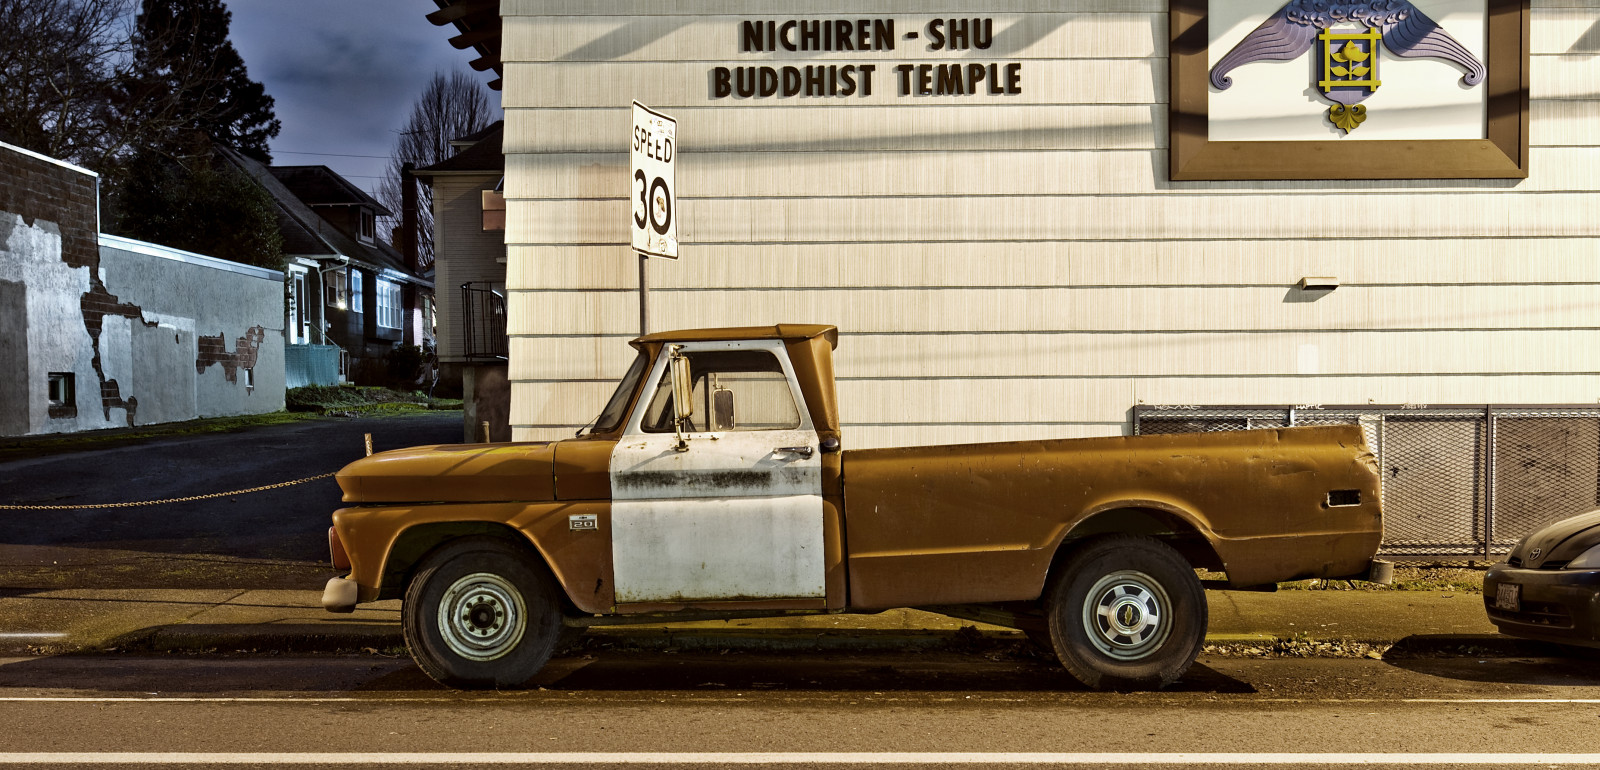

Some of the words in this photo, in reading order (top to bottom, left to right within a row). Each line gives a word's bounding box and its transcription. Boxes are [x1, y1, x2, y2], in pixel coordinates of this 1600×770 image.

[744, 19, 895, 51] NICHIREN
[929, 18, 993, 50] SHU
[714, 64, 876, 98] BUDDHIST
[898, 63, 1022, 96] TEMPLE
[633, 125, 673, 163] SPEED
[634, 168, 672, 235] 30
